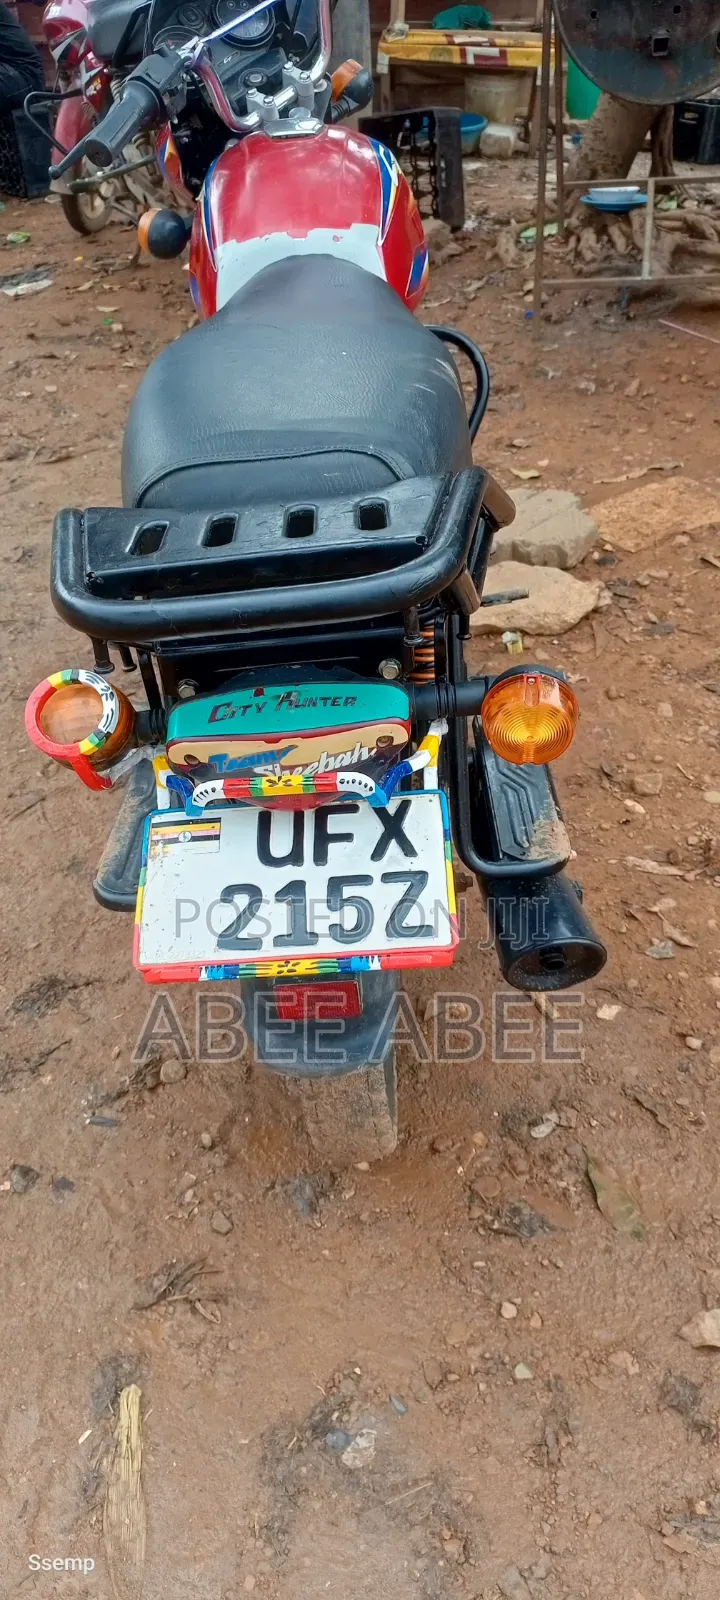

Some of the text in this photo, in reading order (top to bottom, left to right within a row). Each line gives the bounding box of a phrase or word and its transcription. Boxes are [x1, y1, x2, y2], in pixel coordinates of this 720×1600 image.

[208, 691, 357, 723] CITY HUNTER
[256, 799, 418, 868] UFX
[216, 870, 434, 951] 215Z
